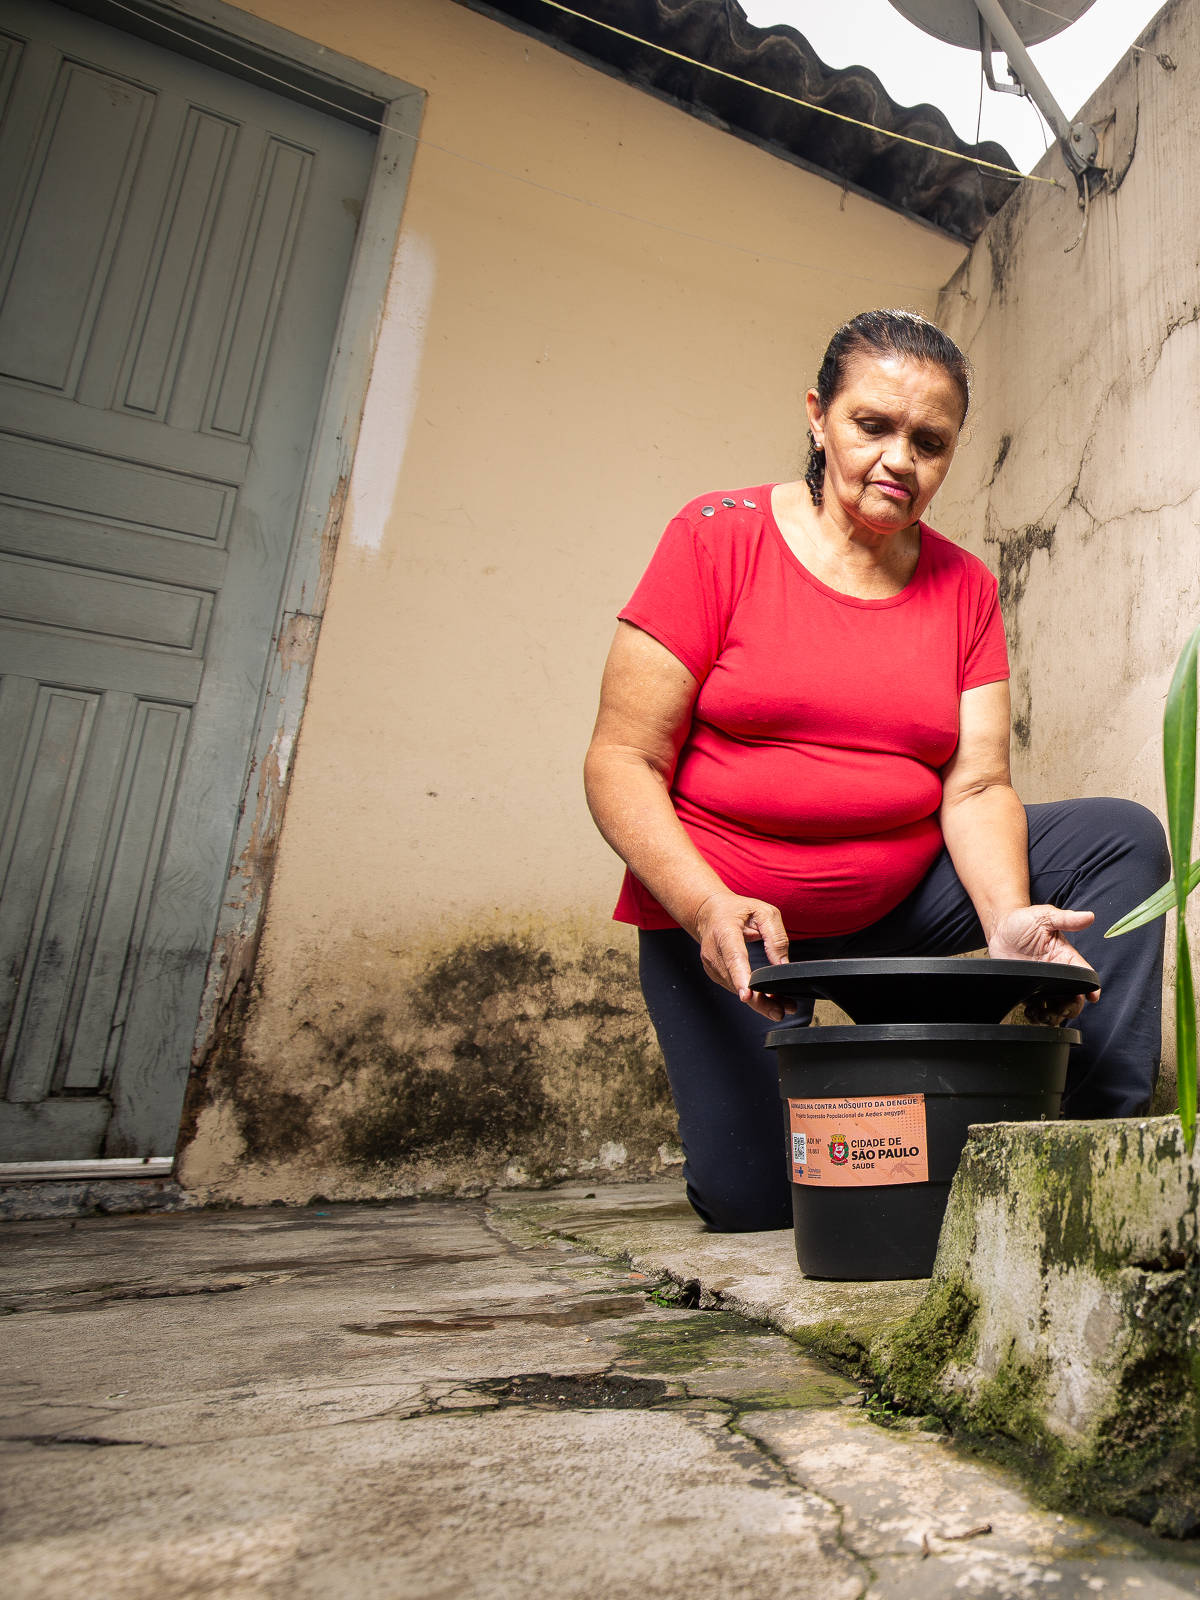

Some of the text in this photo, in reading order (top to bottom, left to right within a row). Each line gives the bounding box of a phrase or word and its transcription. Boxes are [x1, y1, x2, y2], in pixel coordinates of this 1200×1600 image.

[838, 1102, 873, 1110] MOSQUITO
[886, 1098, 918, 1107] DENGUE
[851, 1137, 902, 1148] CIDADE DE
[851, 1146, 920, 1161] SÃO PAULO
